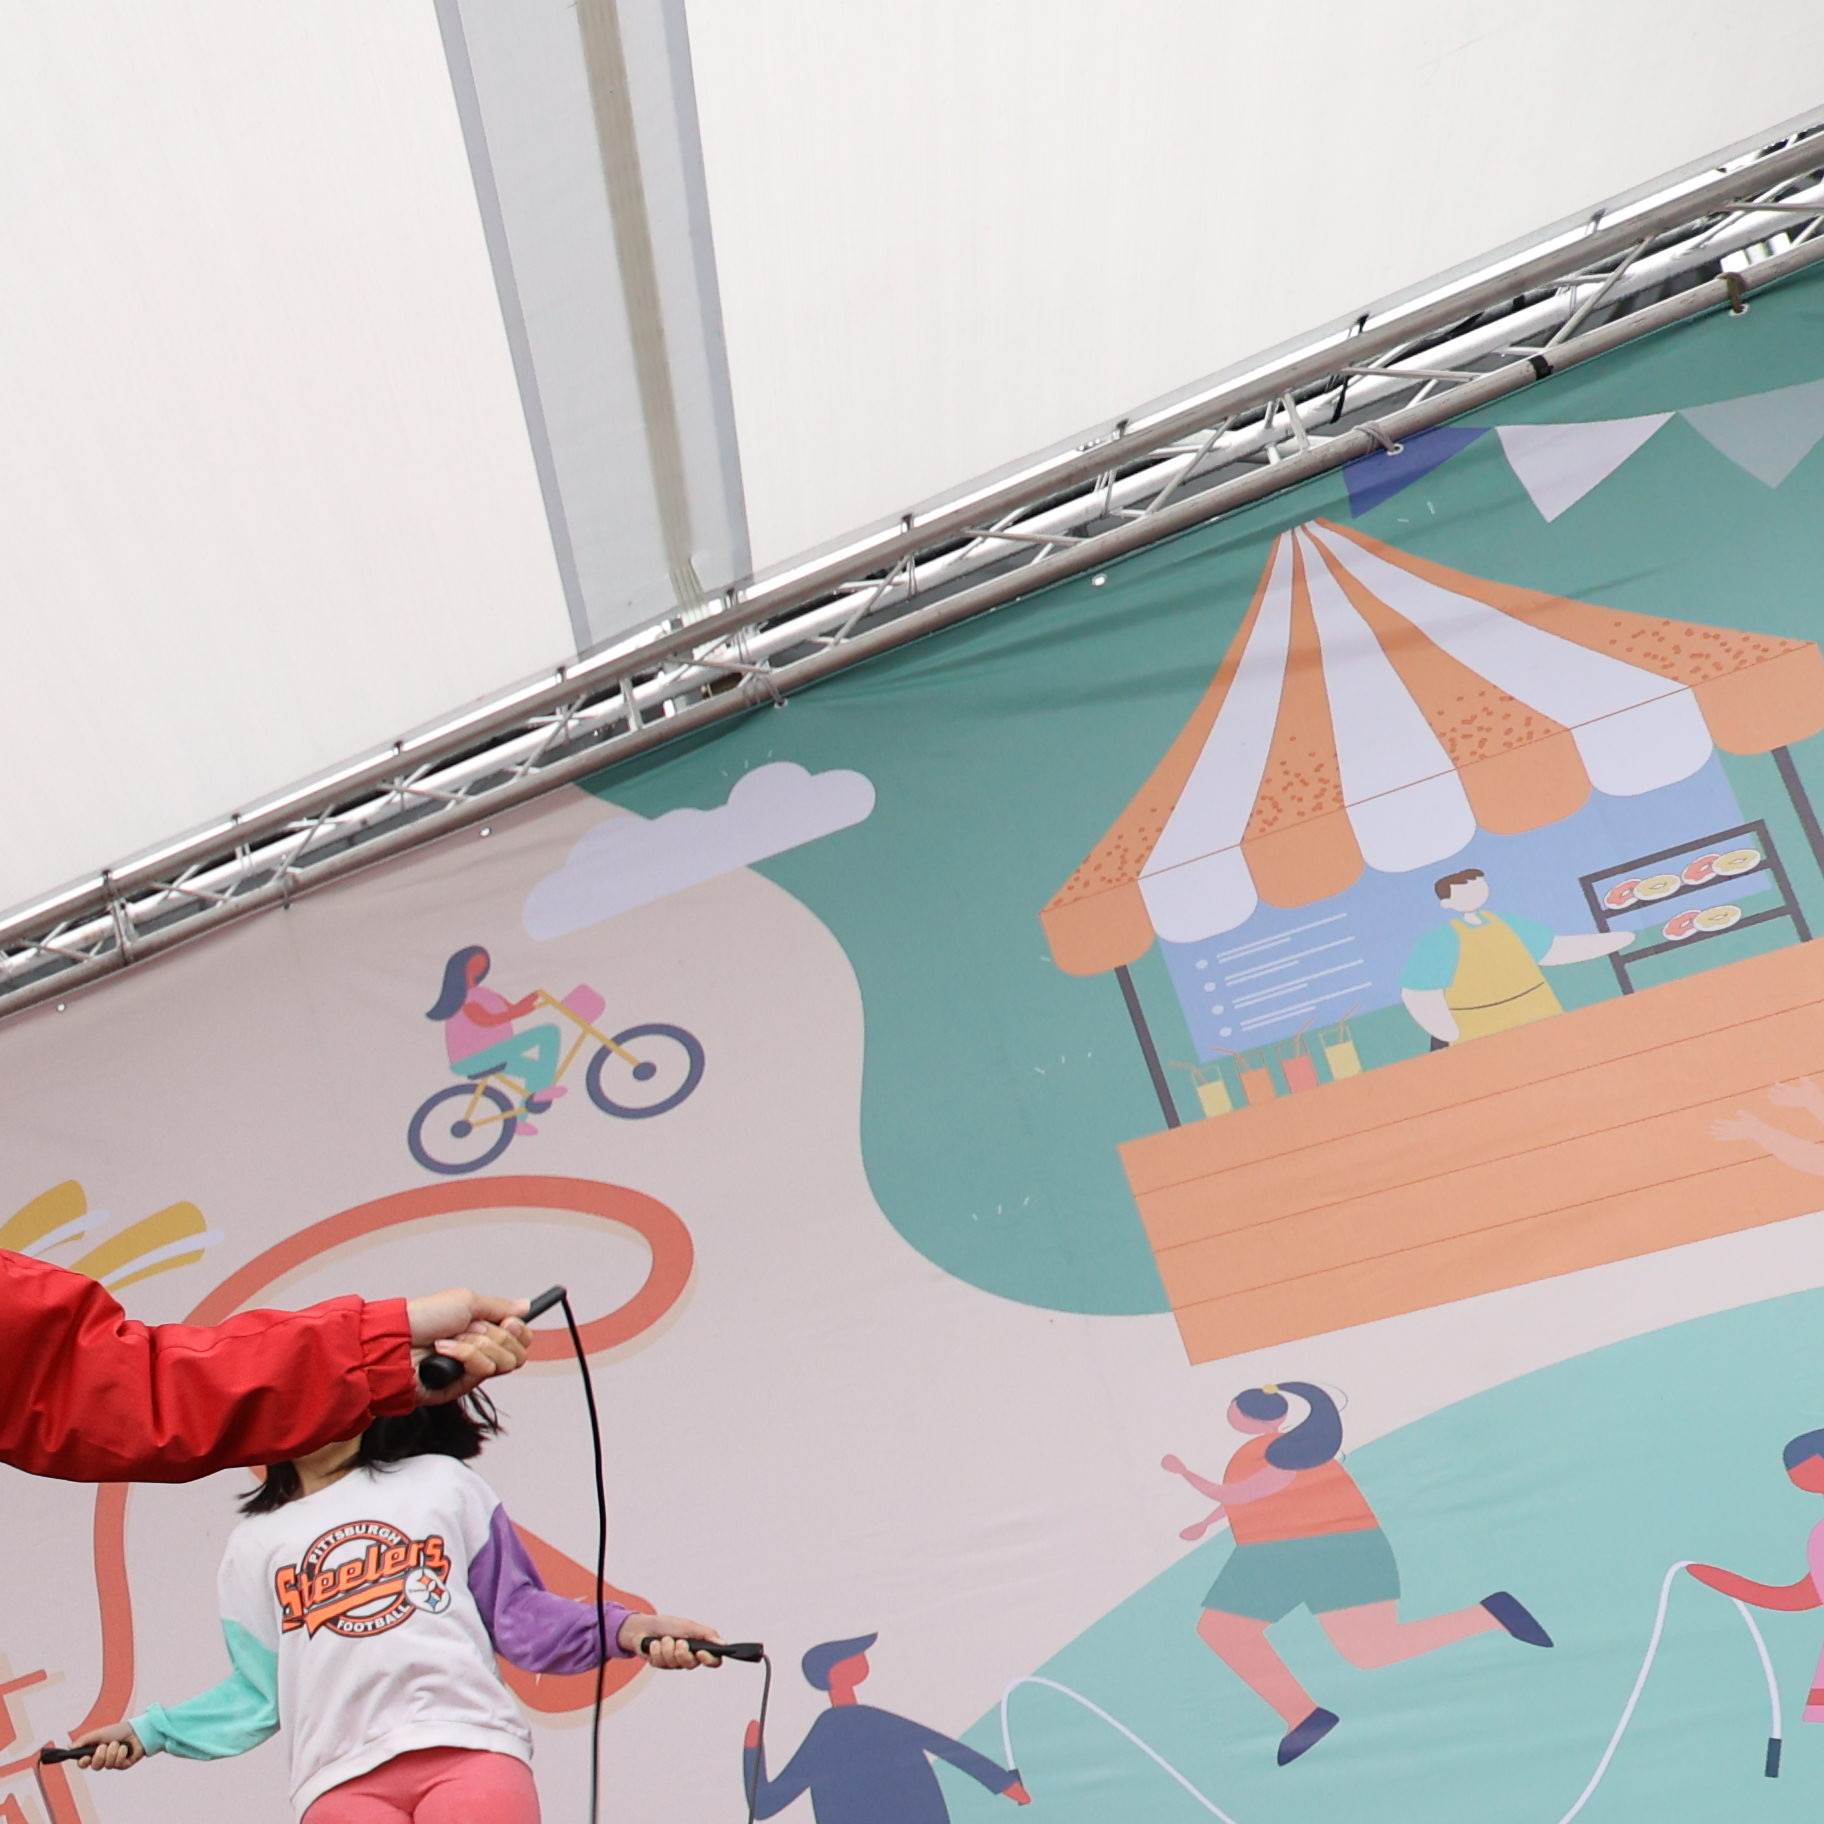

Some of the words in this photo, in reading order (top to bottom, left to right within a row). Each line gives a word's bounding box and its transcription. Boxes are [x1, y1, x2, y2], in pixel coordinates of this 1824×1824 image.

[308, 1523, 402, 1564] PITTSBURGH
[275, 1534, 452, 1618] Steelers
[336, 1604, 410, 1633] FOOTBALL
